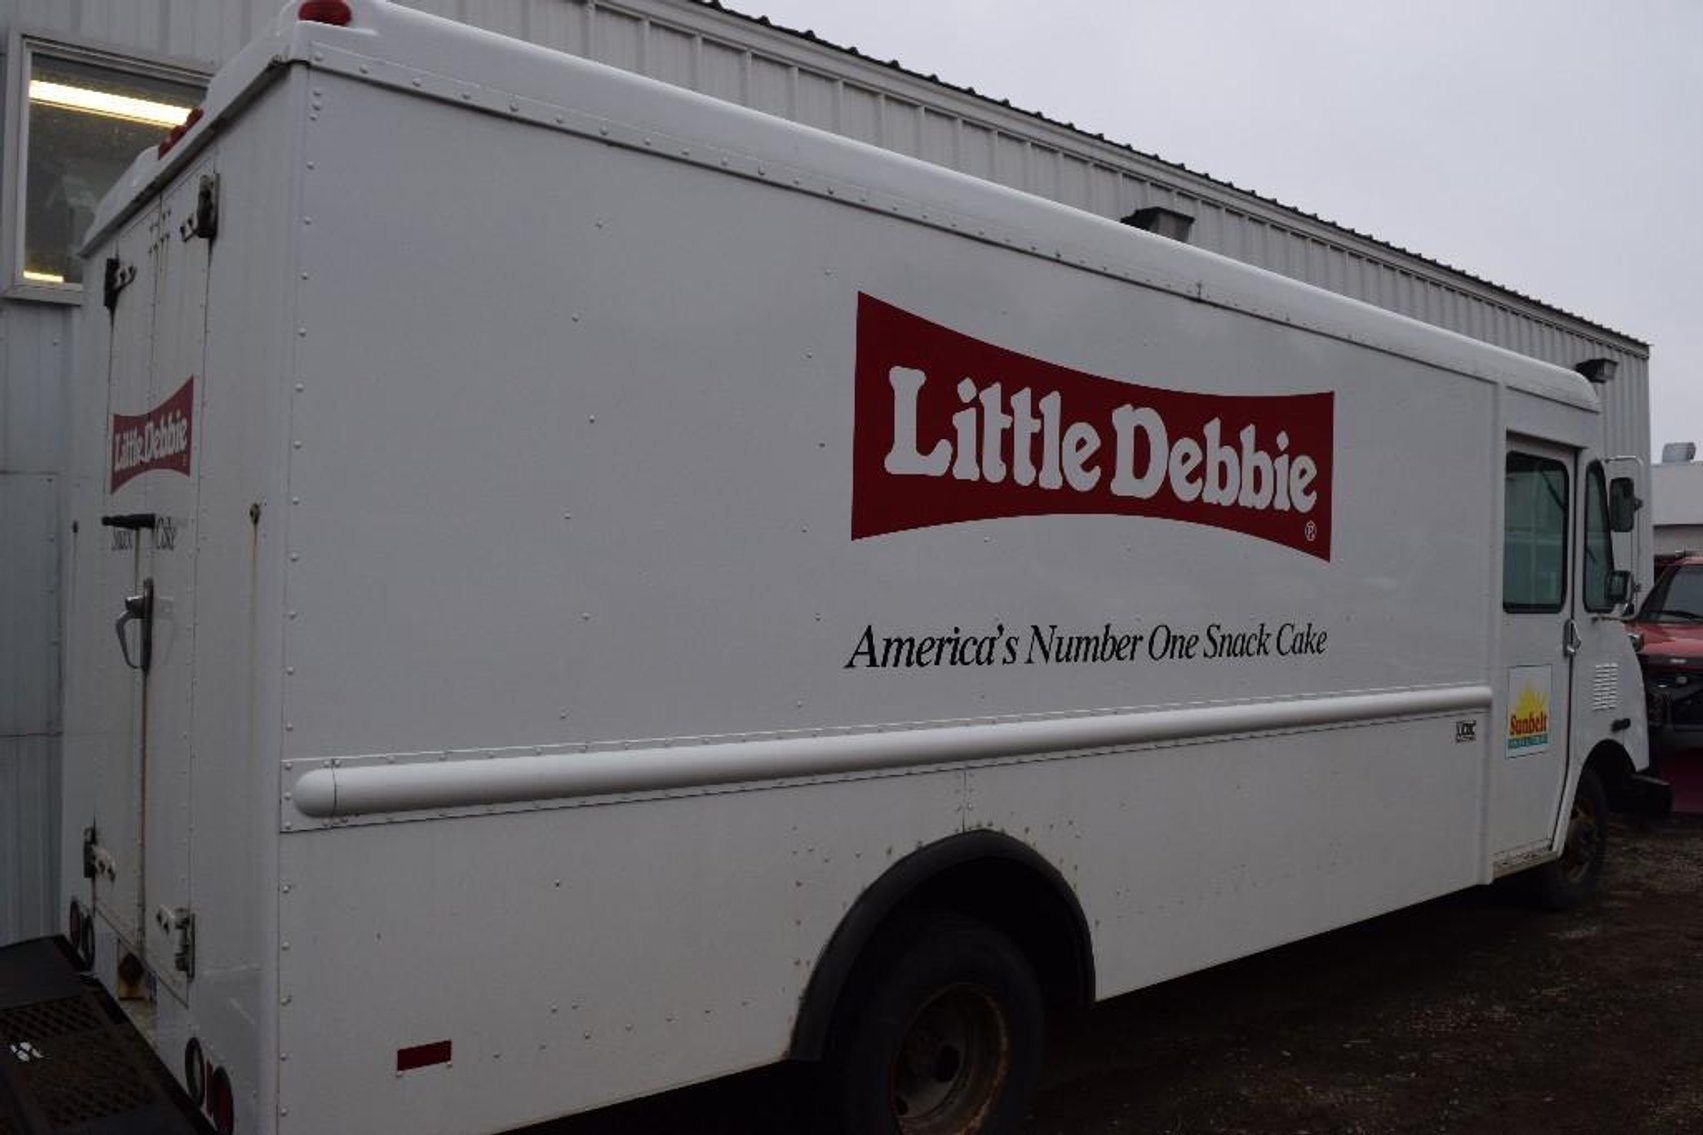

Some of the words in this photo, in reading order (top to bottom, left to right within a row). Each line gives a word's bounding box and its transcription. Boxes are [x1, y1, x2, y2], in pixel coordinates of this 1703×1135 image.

[114, 426, 144, 472] Little
[144, 408, 188, 464] Debbie
[884, 365, 1102, 493] Little
[1109, 403, 1318, 514] Debbie
[844, 624, 1020, 669] America's
[1024, 624, 1143, 665] Number
[1147, 624, 1200, 661] One
[1203, 622, 1272, 659] Snack
[1276, 622, 1328, 657] Cake
[1510, 711, 1547, 736] Sunbelt
